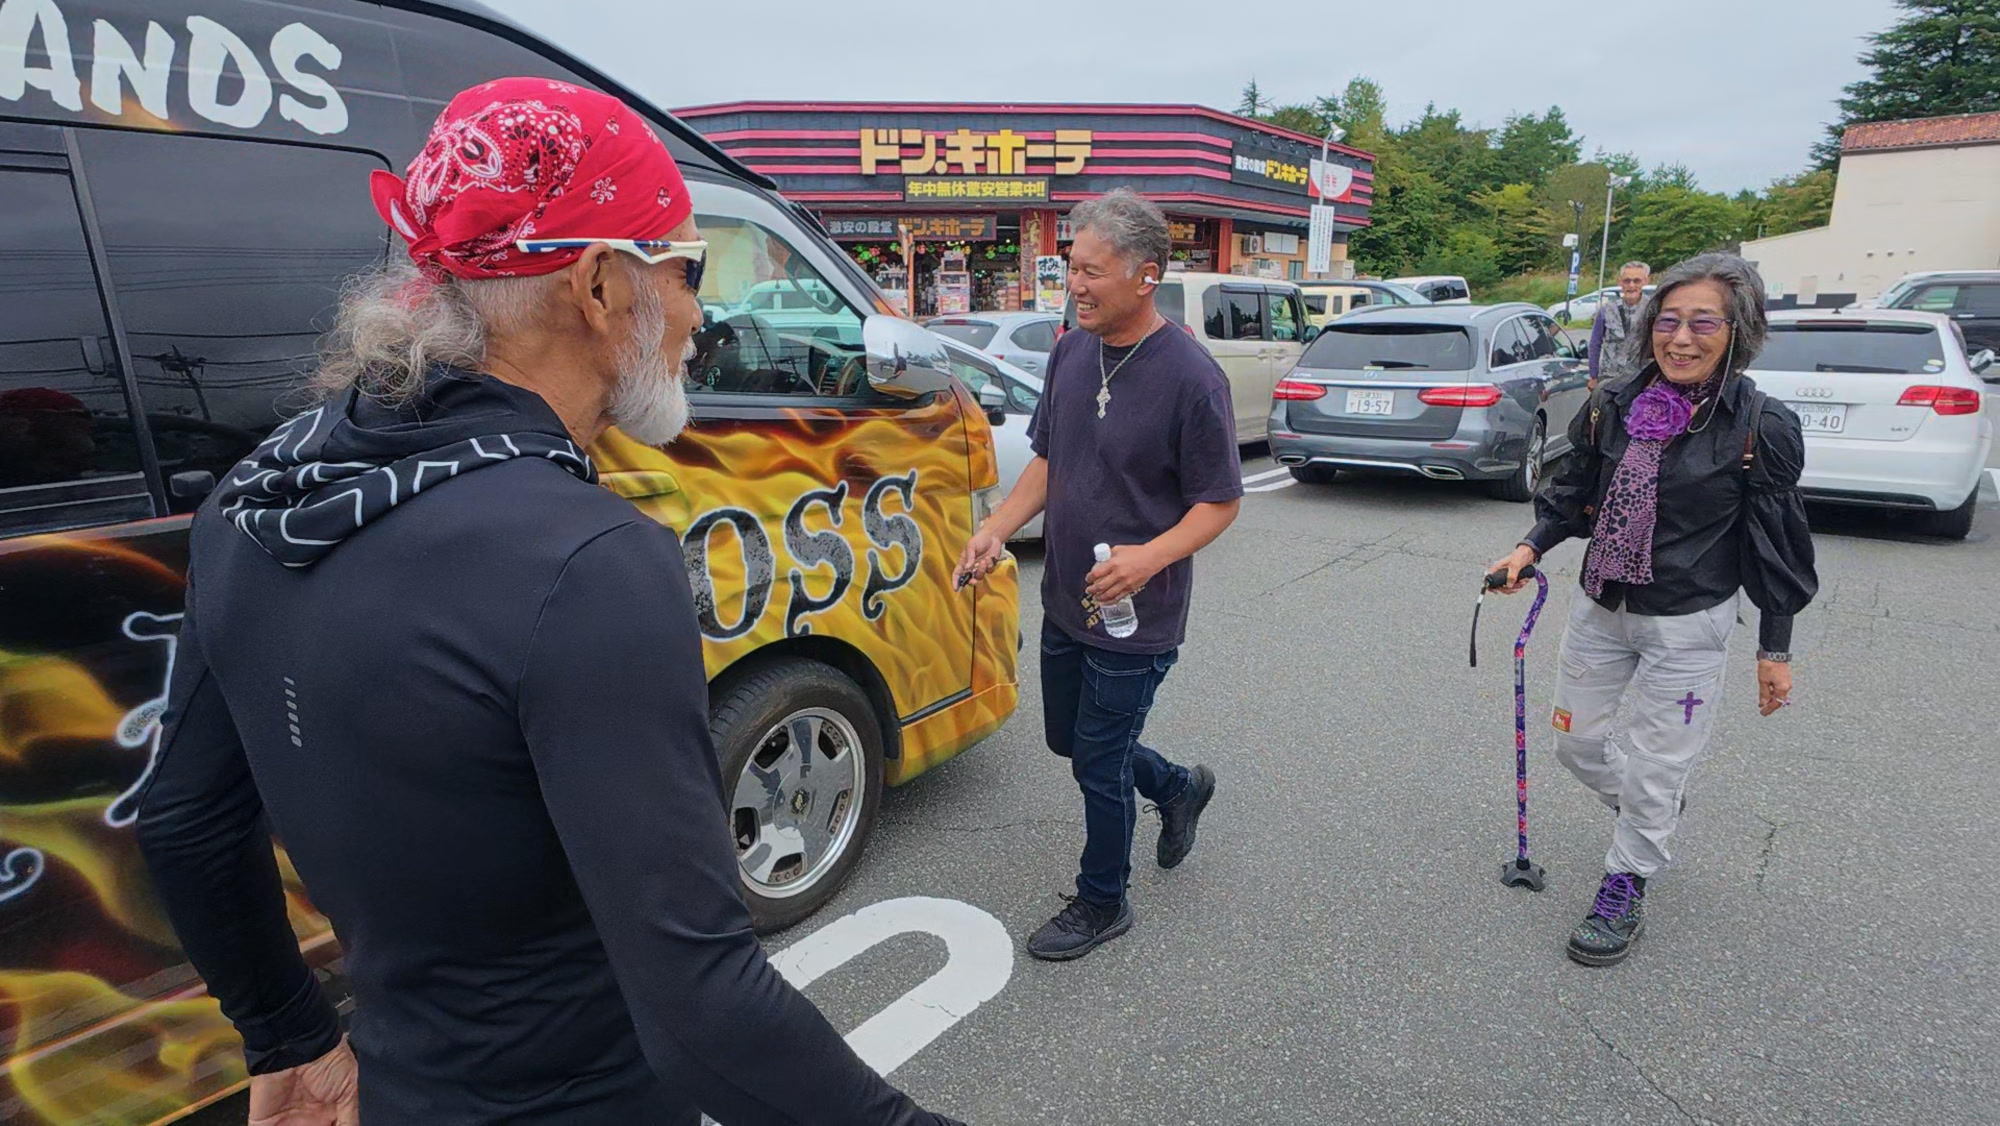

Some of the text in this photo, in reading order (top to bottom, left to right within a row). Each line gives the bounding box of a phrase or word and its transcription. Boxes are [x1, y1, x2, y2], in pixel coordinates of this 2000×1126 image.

[0, 0, 349, 135] ANDS
[1571, 252, 1580, 273] P
[1357, 399, 1390, 413] 19-57
[1801, 414, 1841, 430] 0-40
